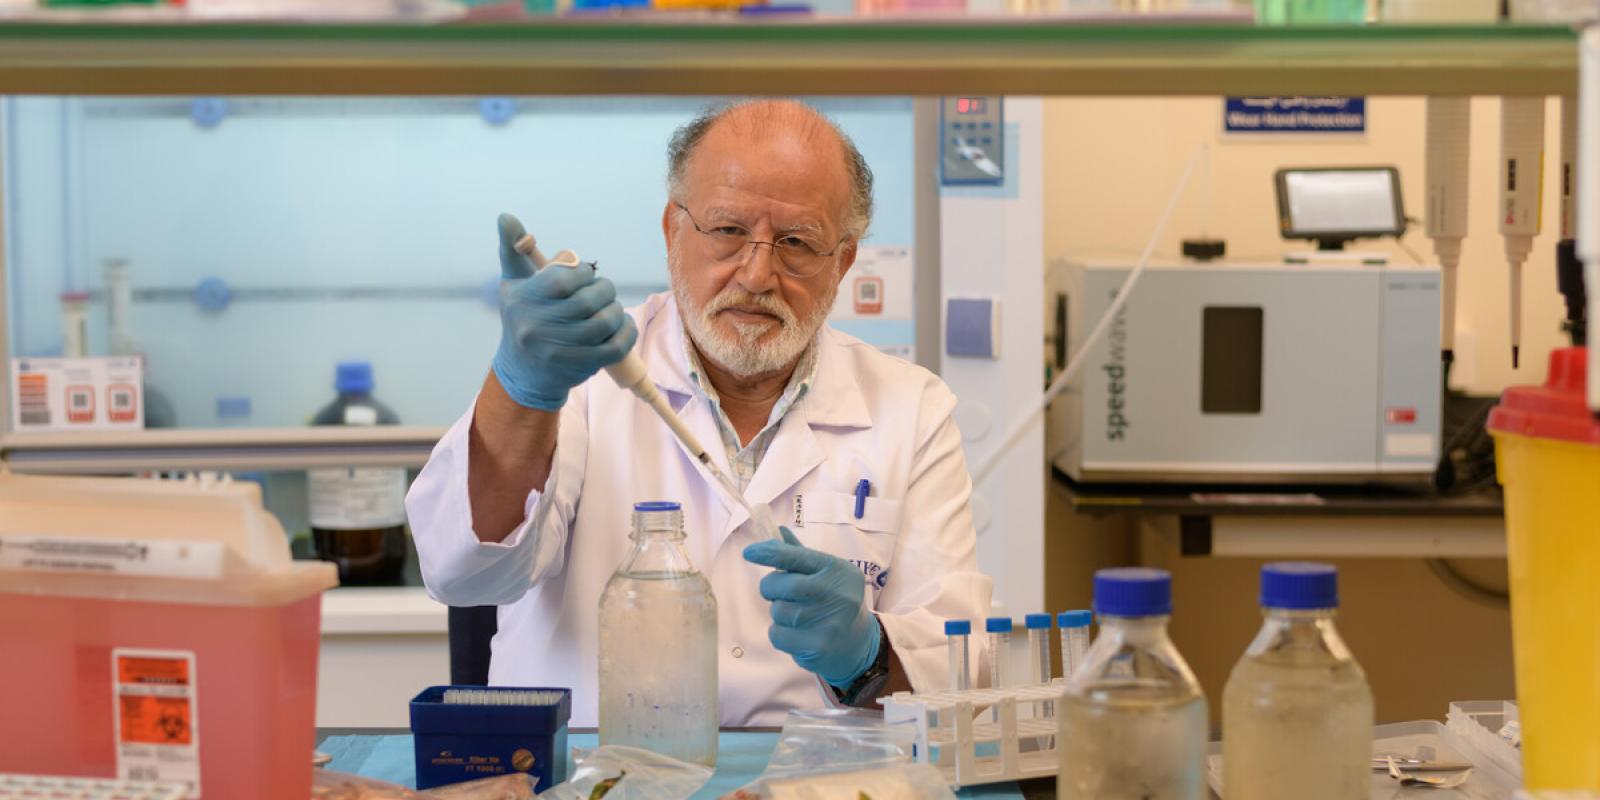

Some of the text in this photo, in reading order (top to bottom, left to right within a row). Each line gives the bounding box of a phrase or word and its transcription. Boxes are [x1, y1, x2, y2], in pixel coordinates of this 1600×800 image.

[1228, 111, 1362, 127] Wear Hand Protection
